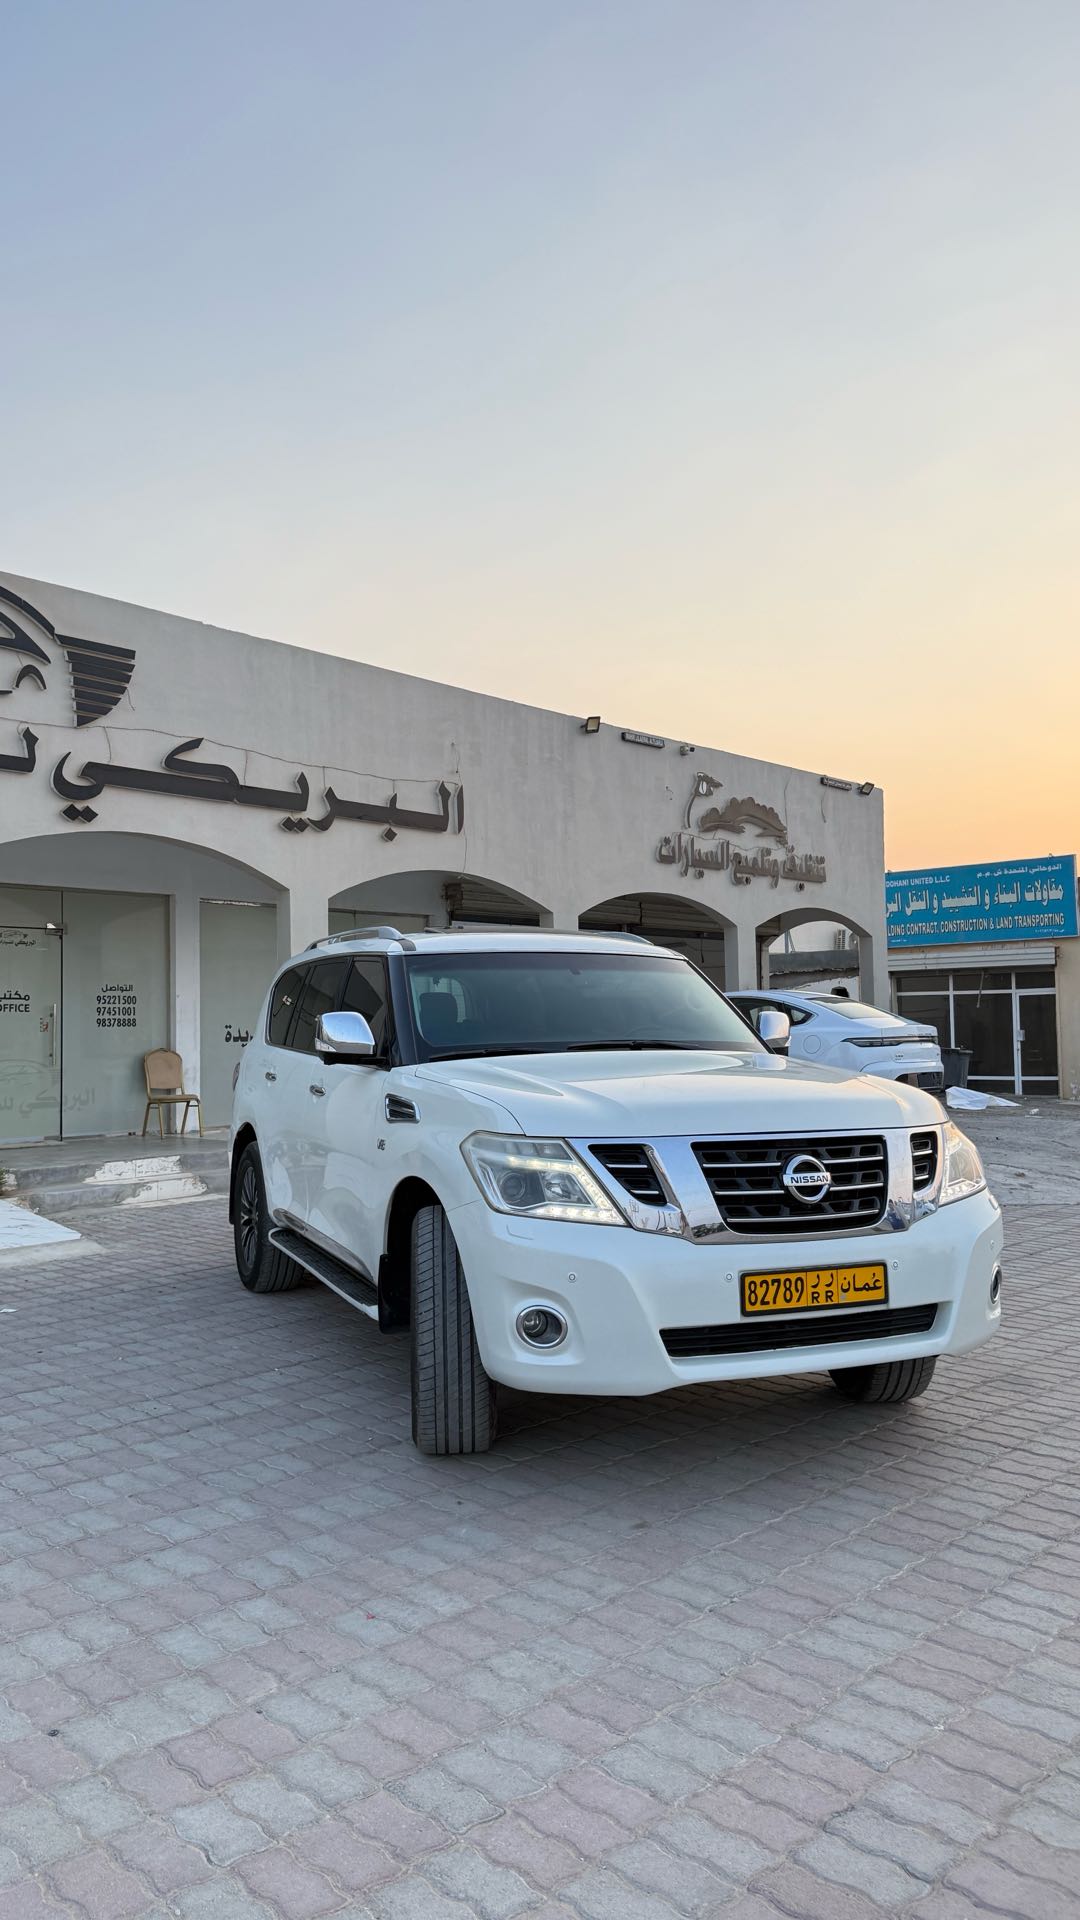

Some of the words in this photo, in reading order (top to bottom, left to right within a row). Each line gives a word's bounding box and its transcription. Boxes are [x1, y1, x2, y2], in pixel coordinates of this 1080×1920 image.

[50, 738, 464, 842] البريكي
[656, 833, 730, 879] السيارات
[910, 877, 934, 886] UNITED
[1024, 878, 1064, 906] مقاولات
[886, 892, 902, 918] البر
[905, 889, 930, 916] النقل
[933, 893, 938, 914] و
[942, 885, 981, 912] التشييد
[984, 889, 990, 911] و
[994, 881, 1020, 908] البناء
[888, 923, 905, 937] LDING
[941, 918, 988, 933] CONSTRUCTION
[989, 918, 995, 929] &
[996, 916, 1013, 929] LAND
[1014, 912, 1065, 928] TRANSPORTING
[96, 995, 137, 1005] 95221500
[101, 984, 134, 993] التواصل
[96, 1006, 136, 1016] 97451001
[96, 1018, 137, 1028] 98378888
[790, 1174, 829, 1184] NISSAN
[748, 1276, 805, 1306] 82789
